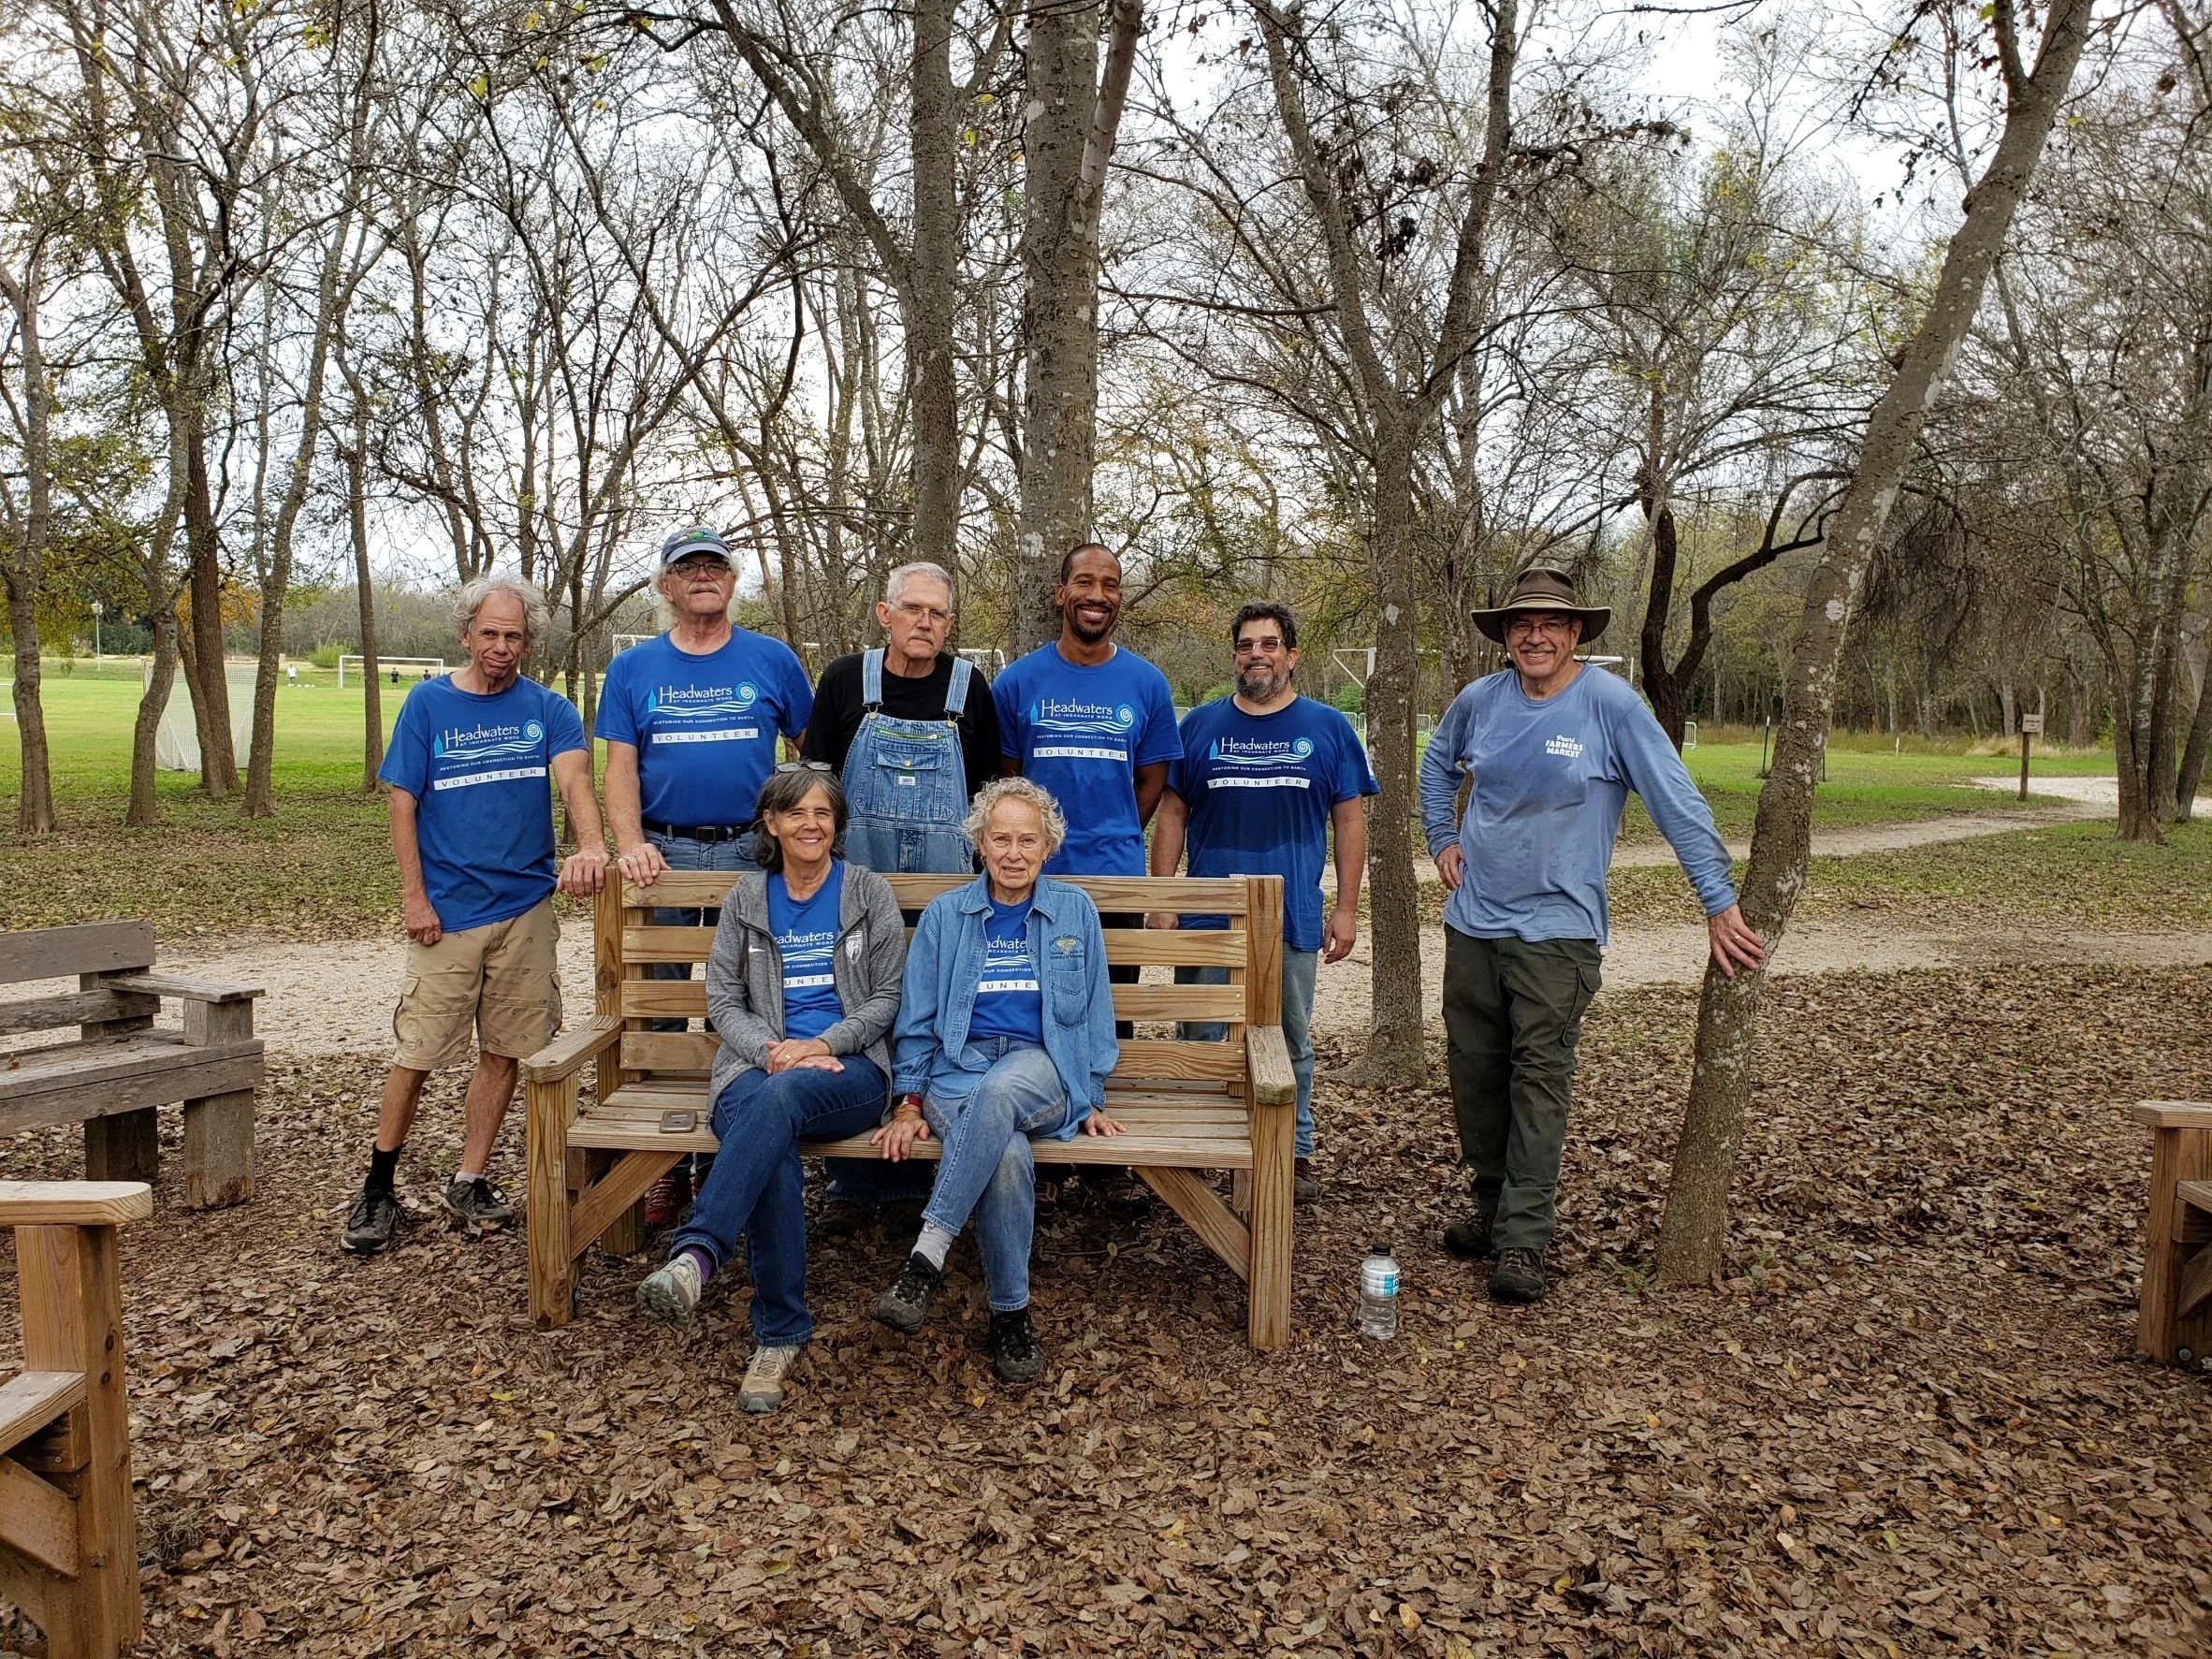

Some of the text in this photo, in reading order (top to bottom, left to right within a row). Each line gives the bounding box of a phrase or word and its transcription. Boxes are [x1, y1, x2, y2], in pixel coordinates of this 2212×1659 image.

[660, 684, 732, 704] Headwaters
[1041, 698, 1113, 718] Headwaters
[444, 723, 520, 749] Headwaters
[469, 737, 502, 746] INCARNATE
[657, 730, 751, 742] VOLUNTEER
[1221, 737, 1290, 753] Headwaters
[1545, 740, 1583, 751] FARMERS
[1546, 747, 1580, 757] MARKET
[1038, 749, 1126, 759] VOLUNTEER
[441, 769, 537, 787] VOLUNTEER
[775, 929, 834, 944] adwaters
[987, 935, 1026, 949] adwate
